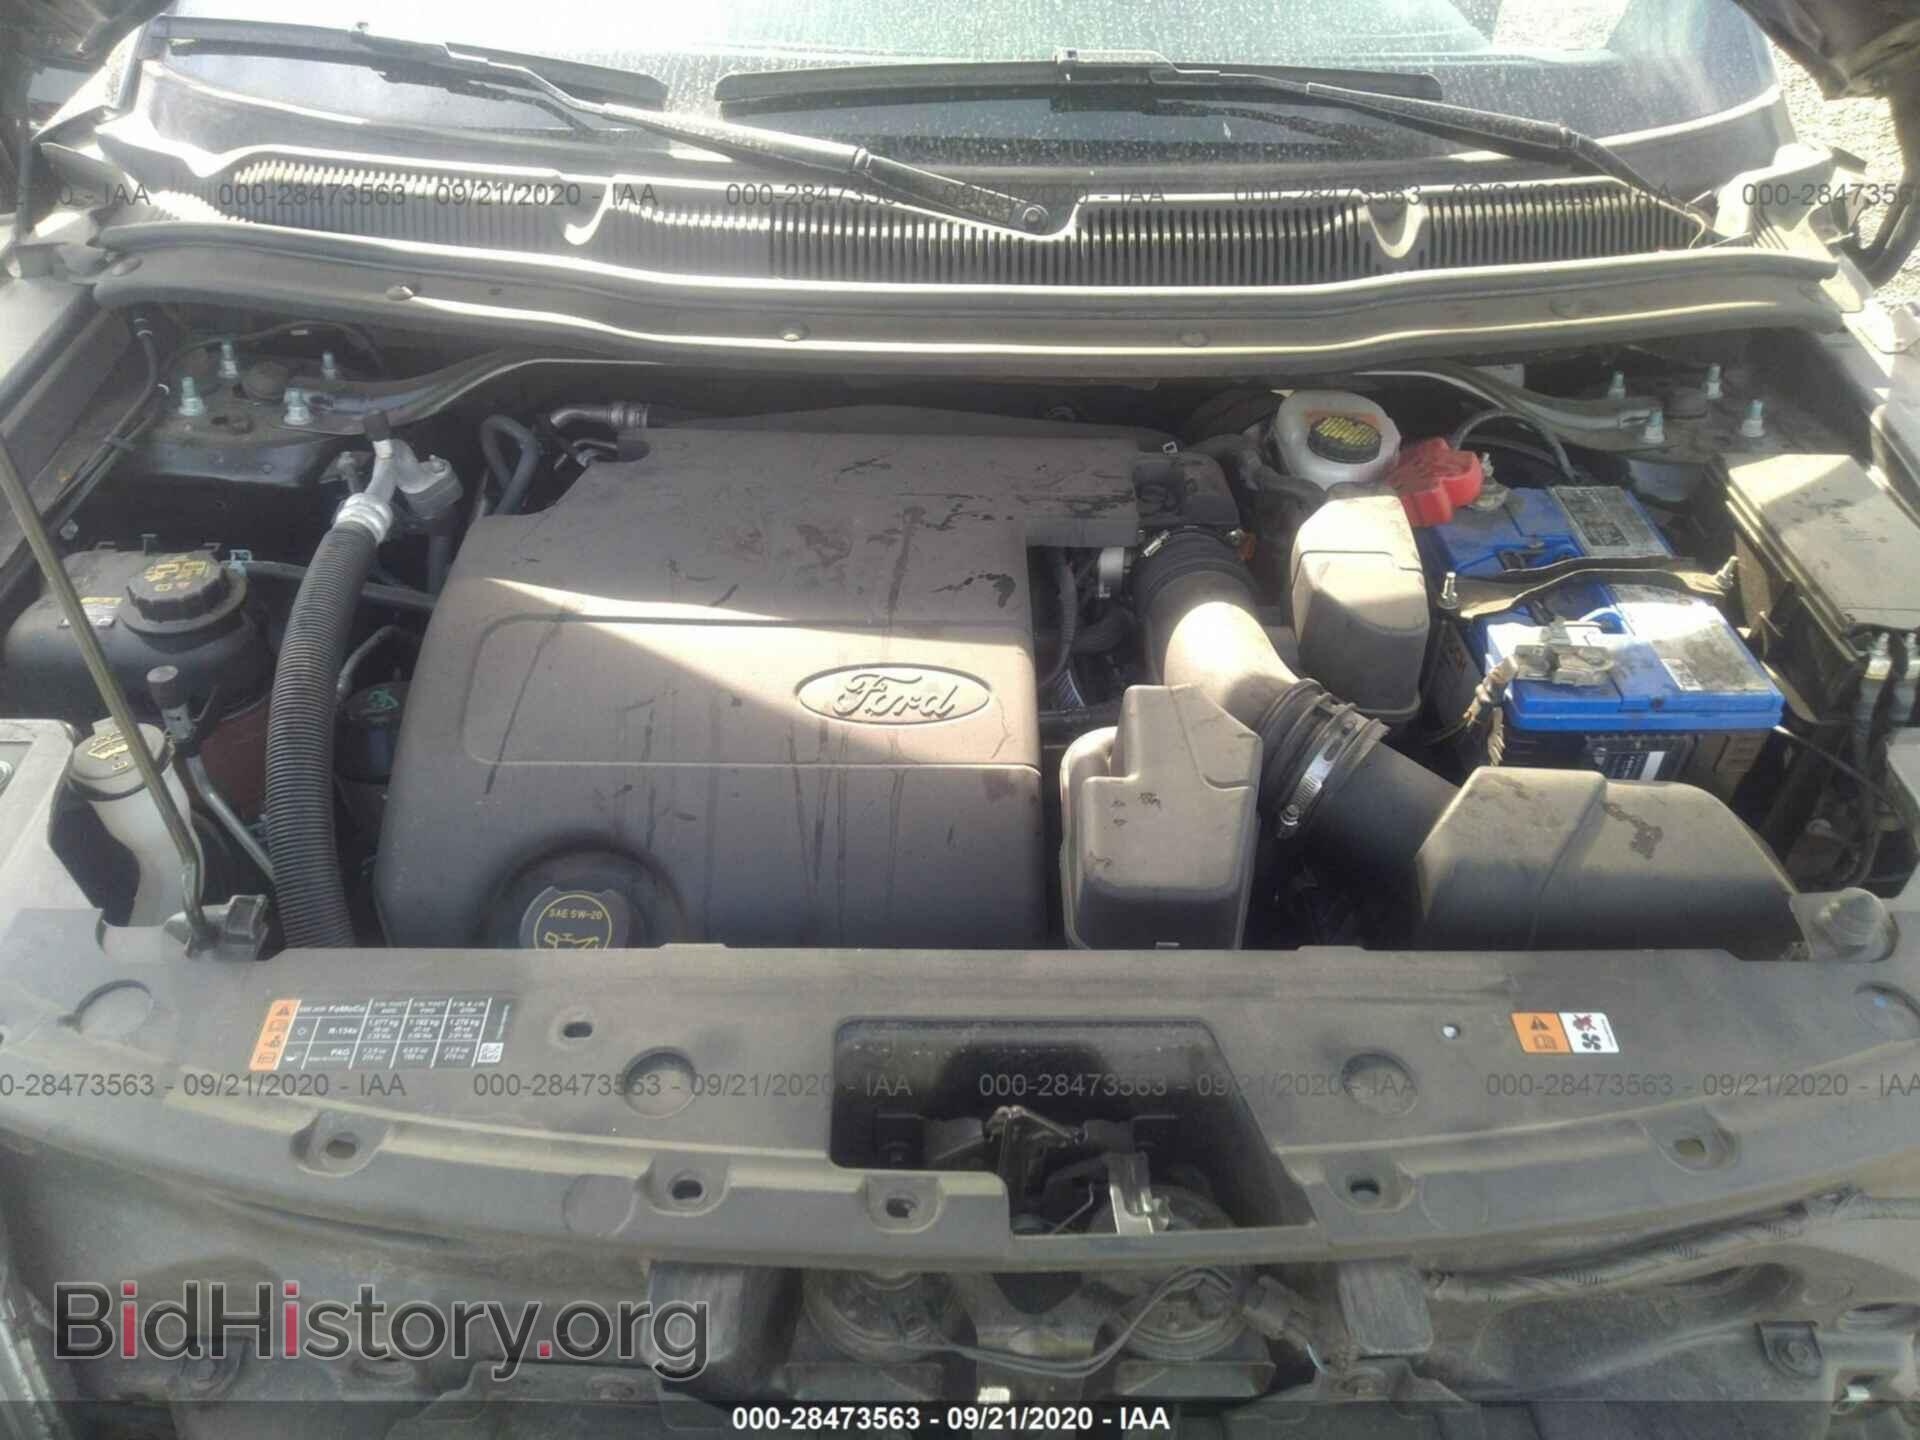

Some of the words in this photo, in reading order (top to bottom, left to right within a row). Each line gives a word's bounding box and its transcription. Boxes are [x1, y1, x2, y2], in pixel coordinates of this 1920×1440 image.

[832, 673, 959, 718] Ford
[549, 908, 569, 919] SAE
[570, 909, 603, 920] 5W-20
